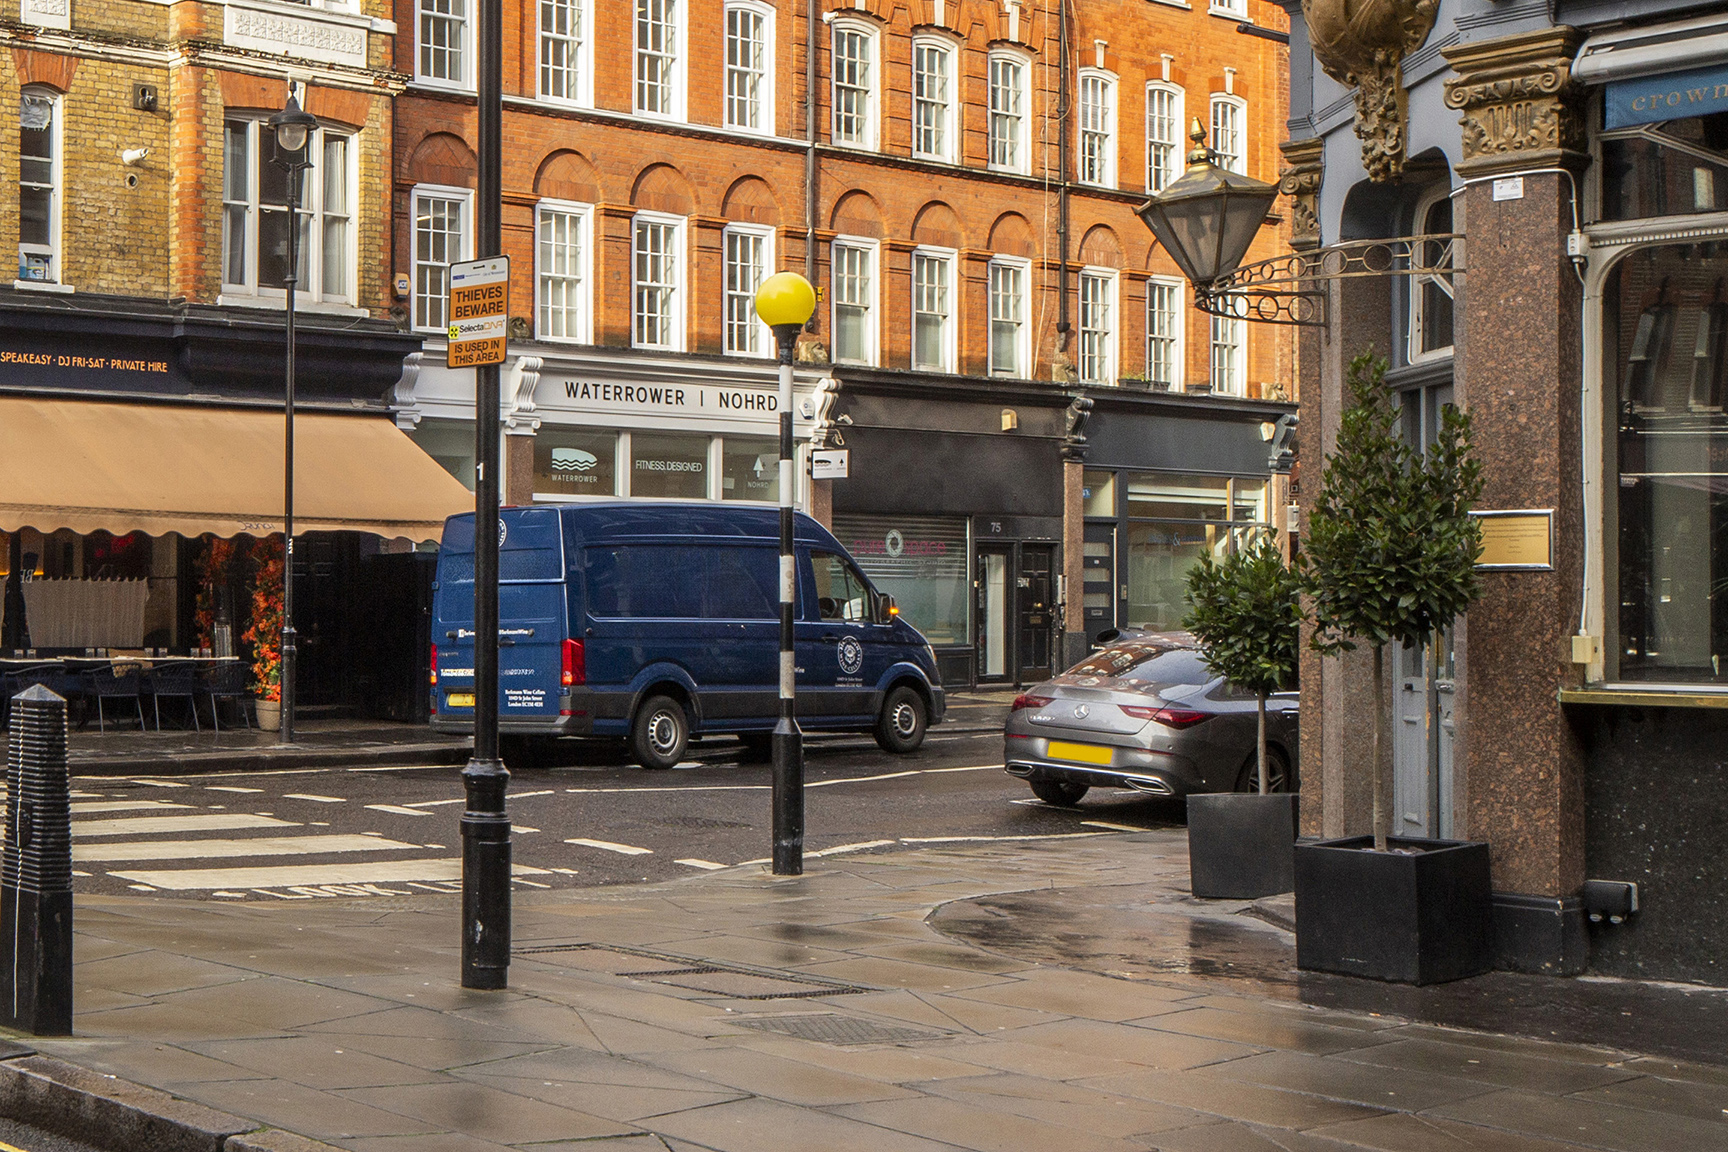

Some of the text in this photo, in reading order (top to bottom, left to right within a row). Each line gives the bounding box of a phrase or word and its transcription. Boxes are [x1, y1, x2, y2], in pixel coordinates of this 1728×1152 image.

[1632, 84, 1728, 111] crown
[455, 286, 503, 303] THIEVES
[455, 301, 503, 318] BEWARE
[455, 340, 500, 353] IS USED IN
[0, 351, 52, 365] SPEAKEASY
[58, 356, 70, 366] DJ
[72, 357, 105, 369] FRI-SAT
[111, 359, 146, 371] PRIVATE
[147, 362, 168, 373] HIRE
[454, 352, 500, 364] THIS AREA
[564, 381, 778, 411] WATERROWER NOHRD
[635, 460, 703, 473] FITNESS.DESIGNED
[551, 474, 598, 483] WATERROWER
[990, 522, 1002, 533] 75
[251, 884, 412, 899] LOOK
